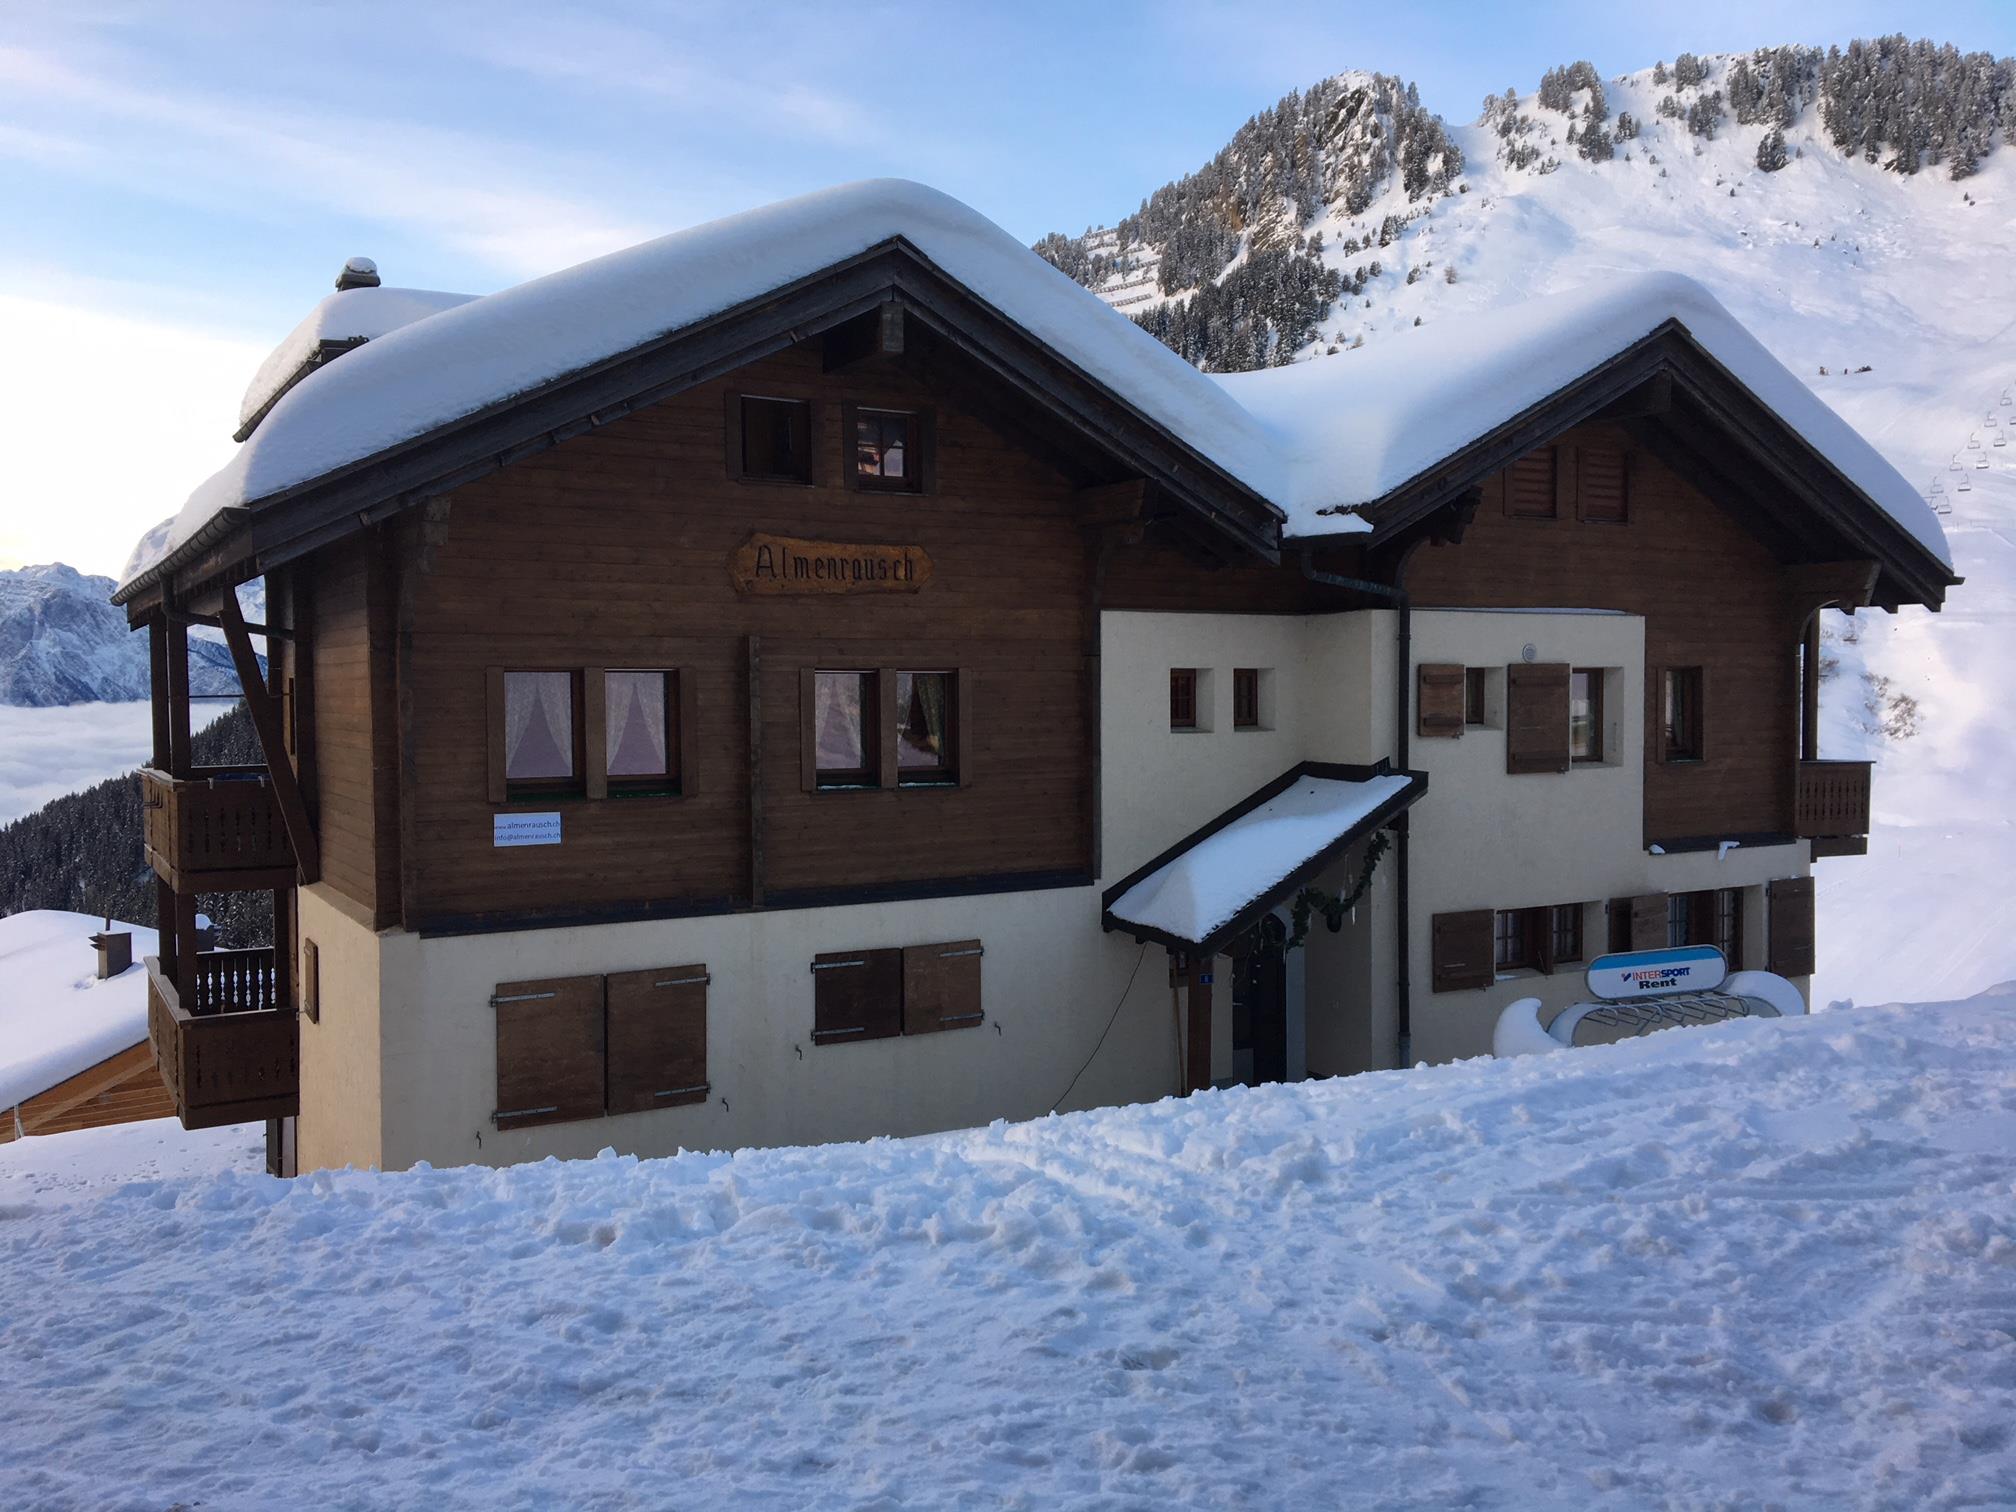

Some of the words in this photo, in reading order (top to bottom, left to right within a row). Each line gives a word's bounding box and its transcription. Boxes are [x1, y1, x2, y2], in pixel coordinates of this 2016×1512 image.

[756, 544, 914, 582] Almenrausch
[1632, 967, 1691, 981] INTERSPORT
[1639, 978, 1677, 989] Rent
